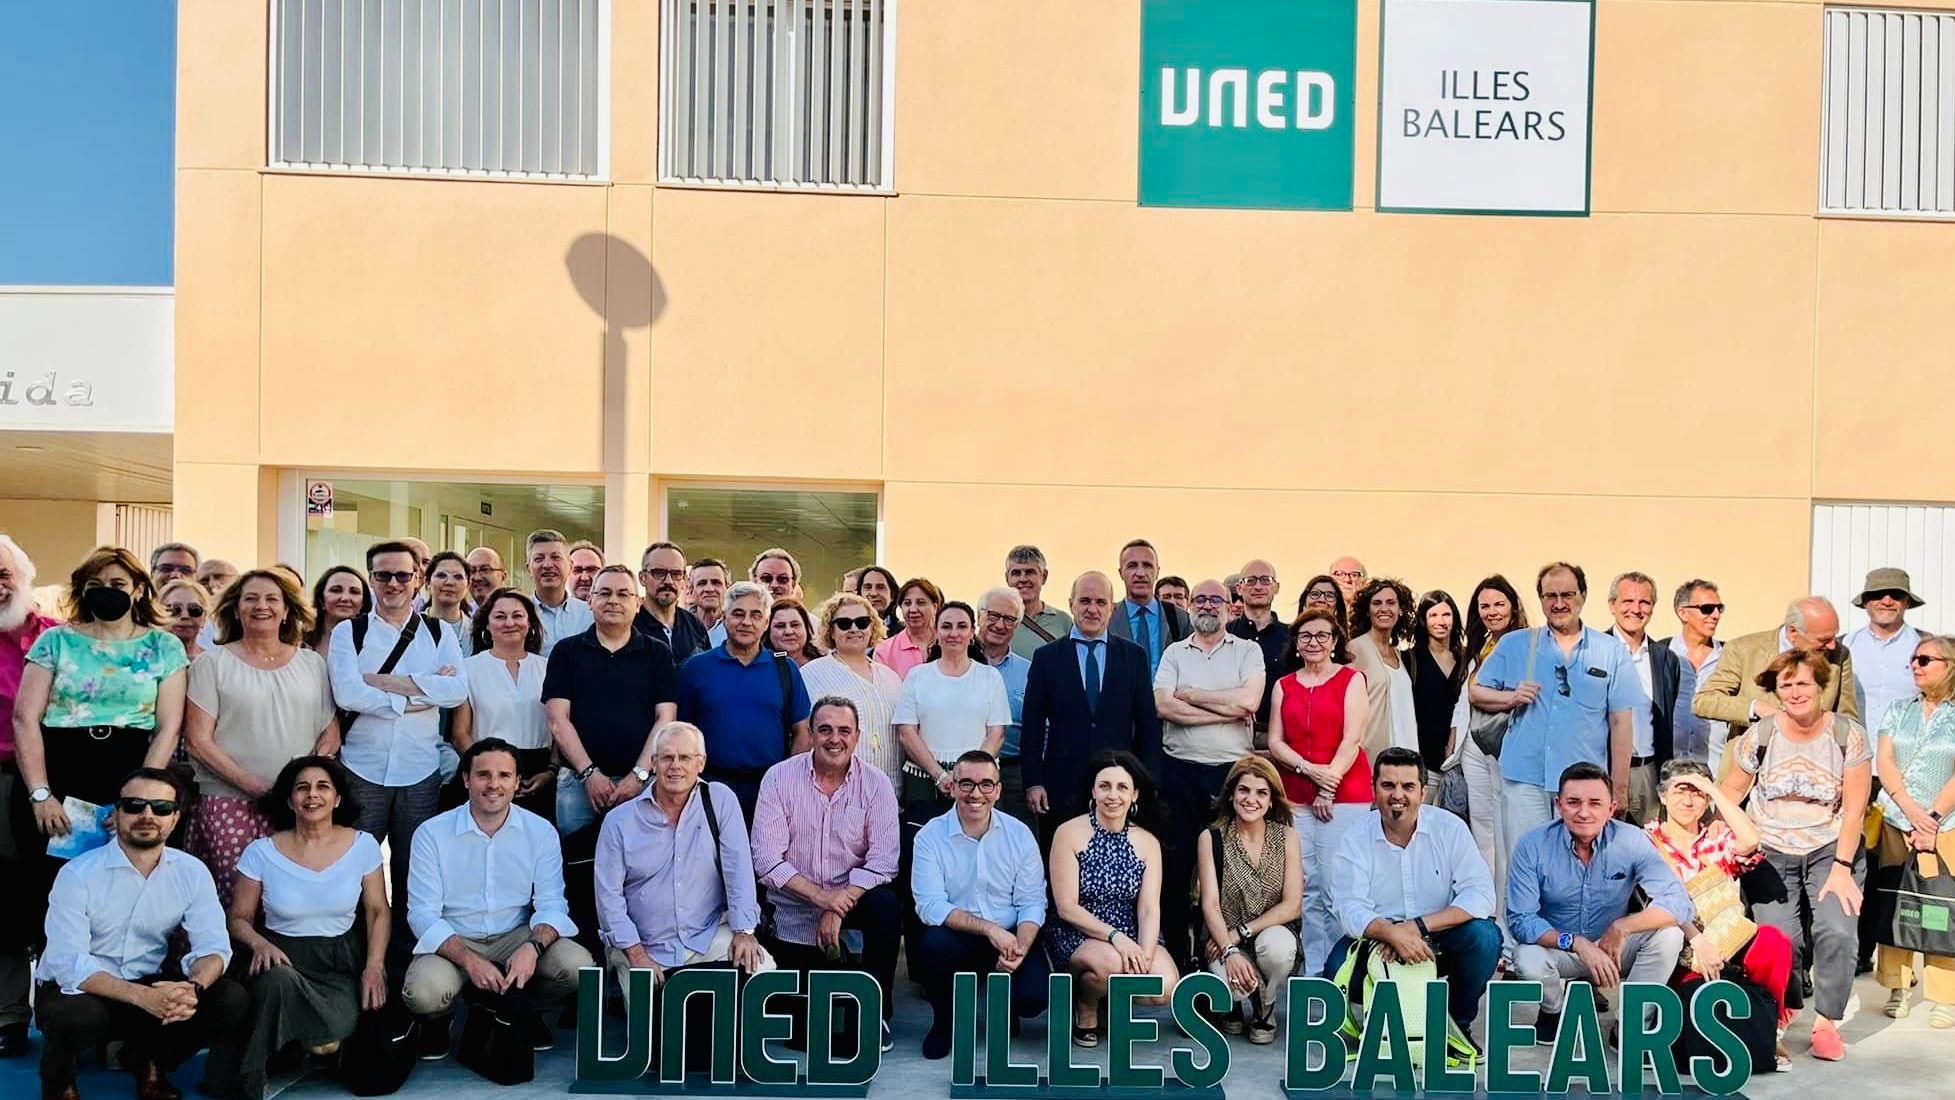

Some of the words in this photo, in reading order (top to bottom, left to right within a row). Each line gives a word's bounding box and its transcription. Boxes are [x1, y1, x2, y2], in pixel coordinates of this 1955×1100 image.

[1160, 68, 1335, 129] UNED
[1441, 70, 1531, 101] ILLES
[1403, 108, 1566, 141] BALEARS
[576, 967, 883, 1085] UNED
[951, 971, 1234, 1088] ILLES
[1284, 976, 1753, 1097] BALEARS
